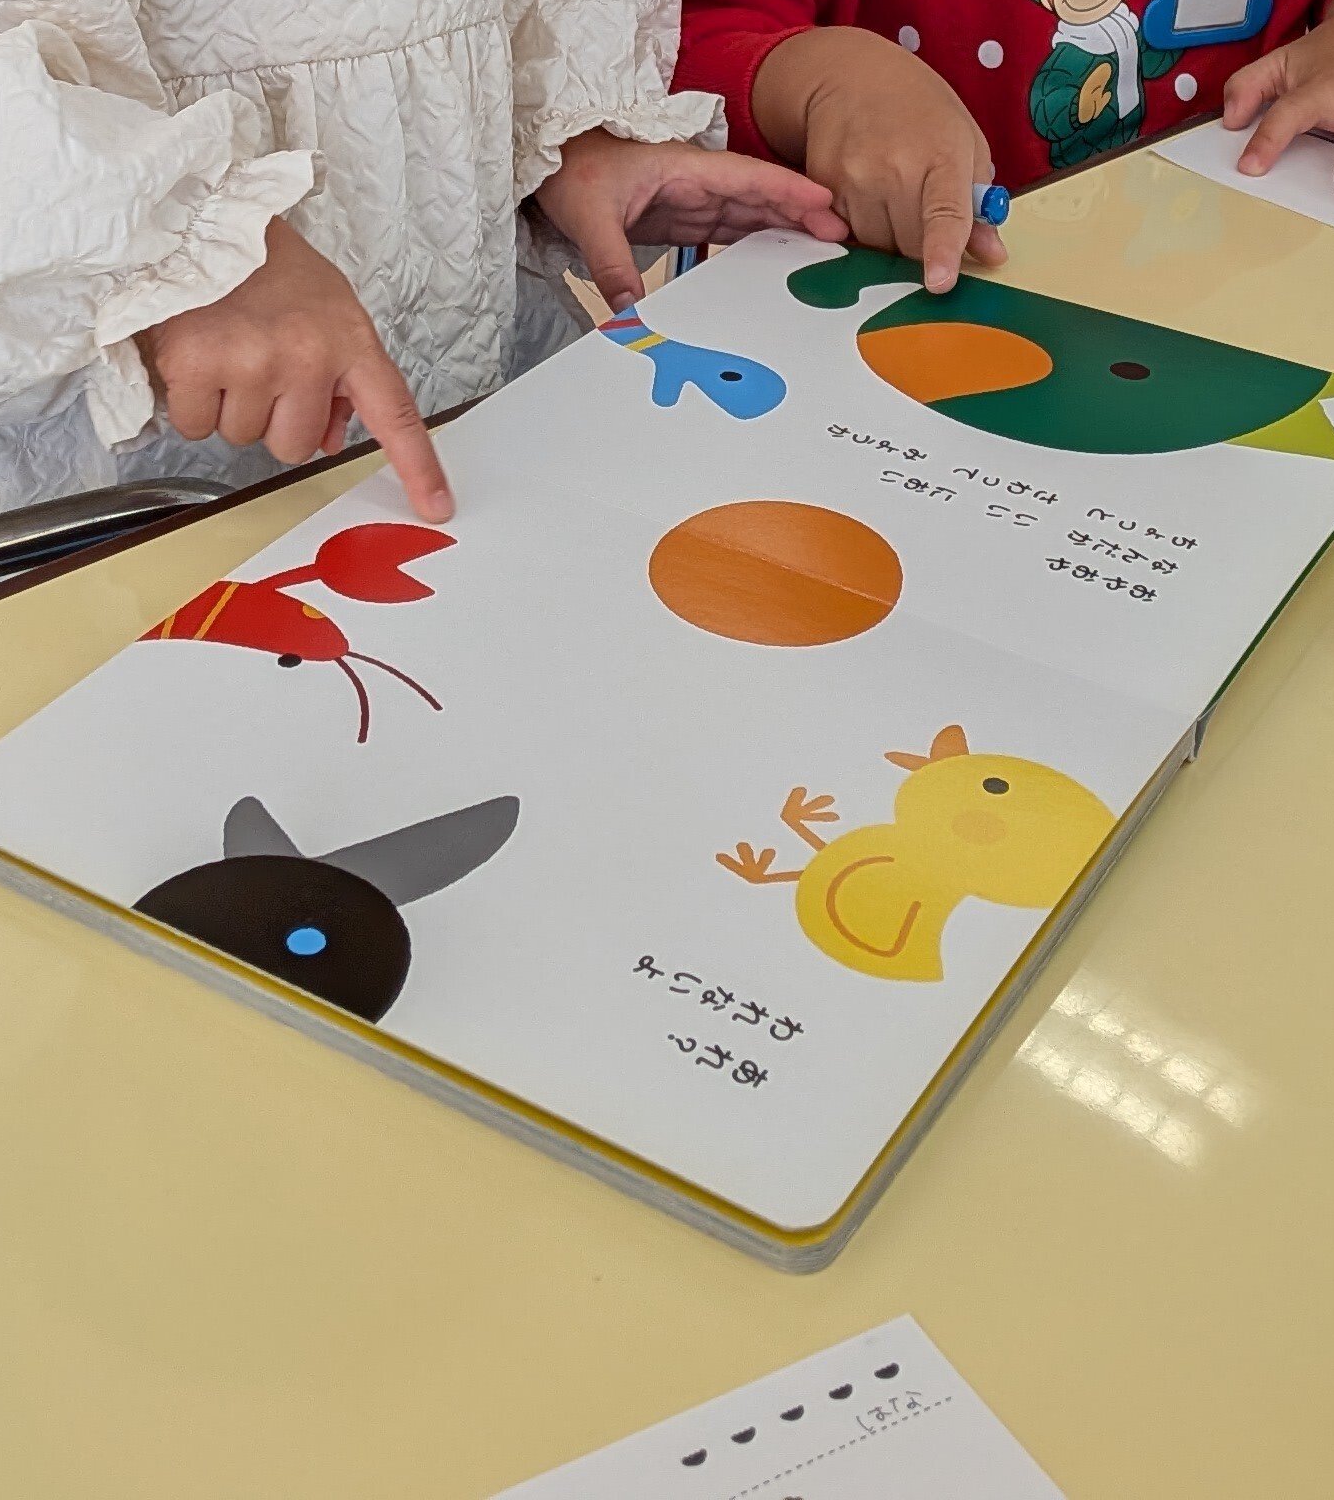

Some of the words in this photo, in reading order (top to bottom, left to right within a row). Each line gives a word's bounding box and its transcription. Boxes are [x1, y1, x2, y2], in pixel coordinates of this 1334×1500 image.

[827, 423, 928, 462] みようか
[880, 470, 958, 502] におい
[953, 466, 1059, 506] さわって
[986, 503, 1039, 527] いい
[1087, 507, 1199, 551] ちょっと
[1067, 529, 1179, 575] なんだか
[1045, 557, 1159, 602] おやおや
[632, 954, 805, 1042] われないよ
[667, 1037, 768, 1089] あれ?
